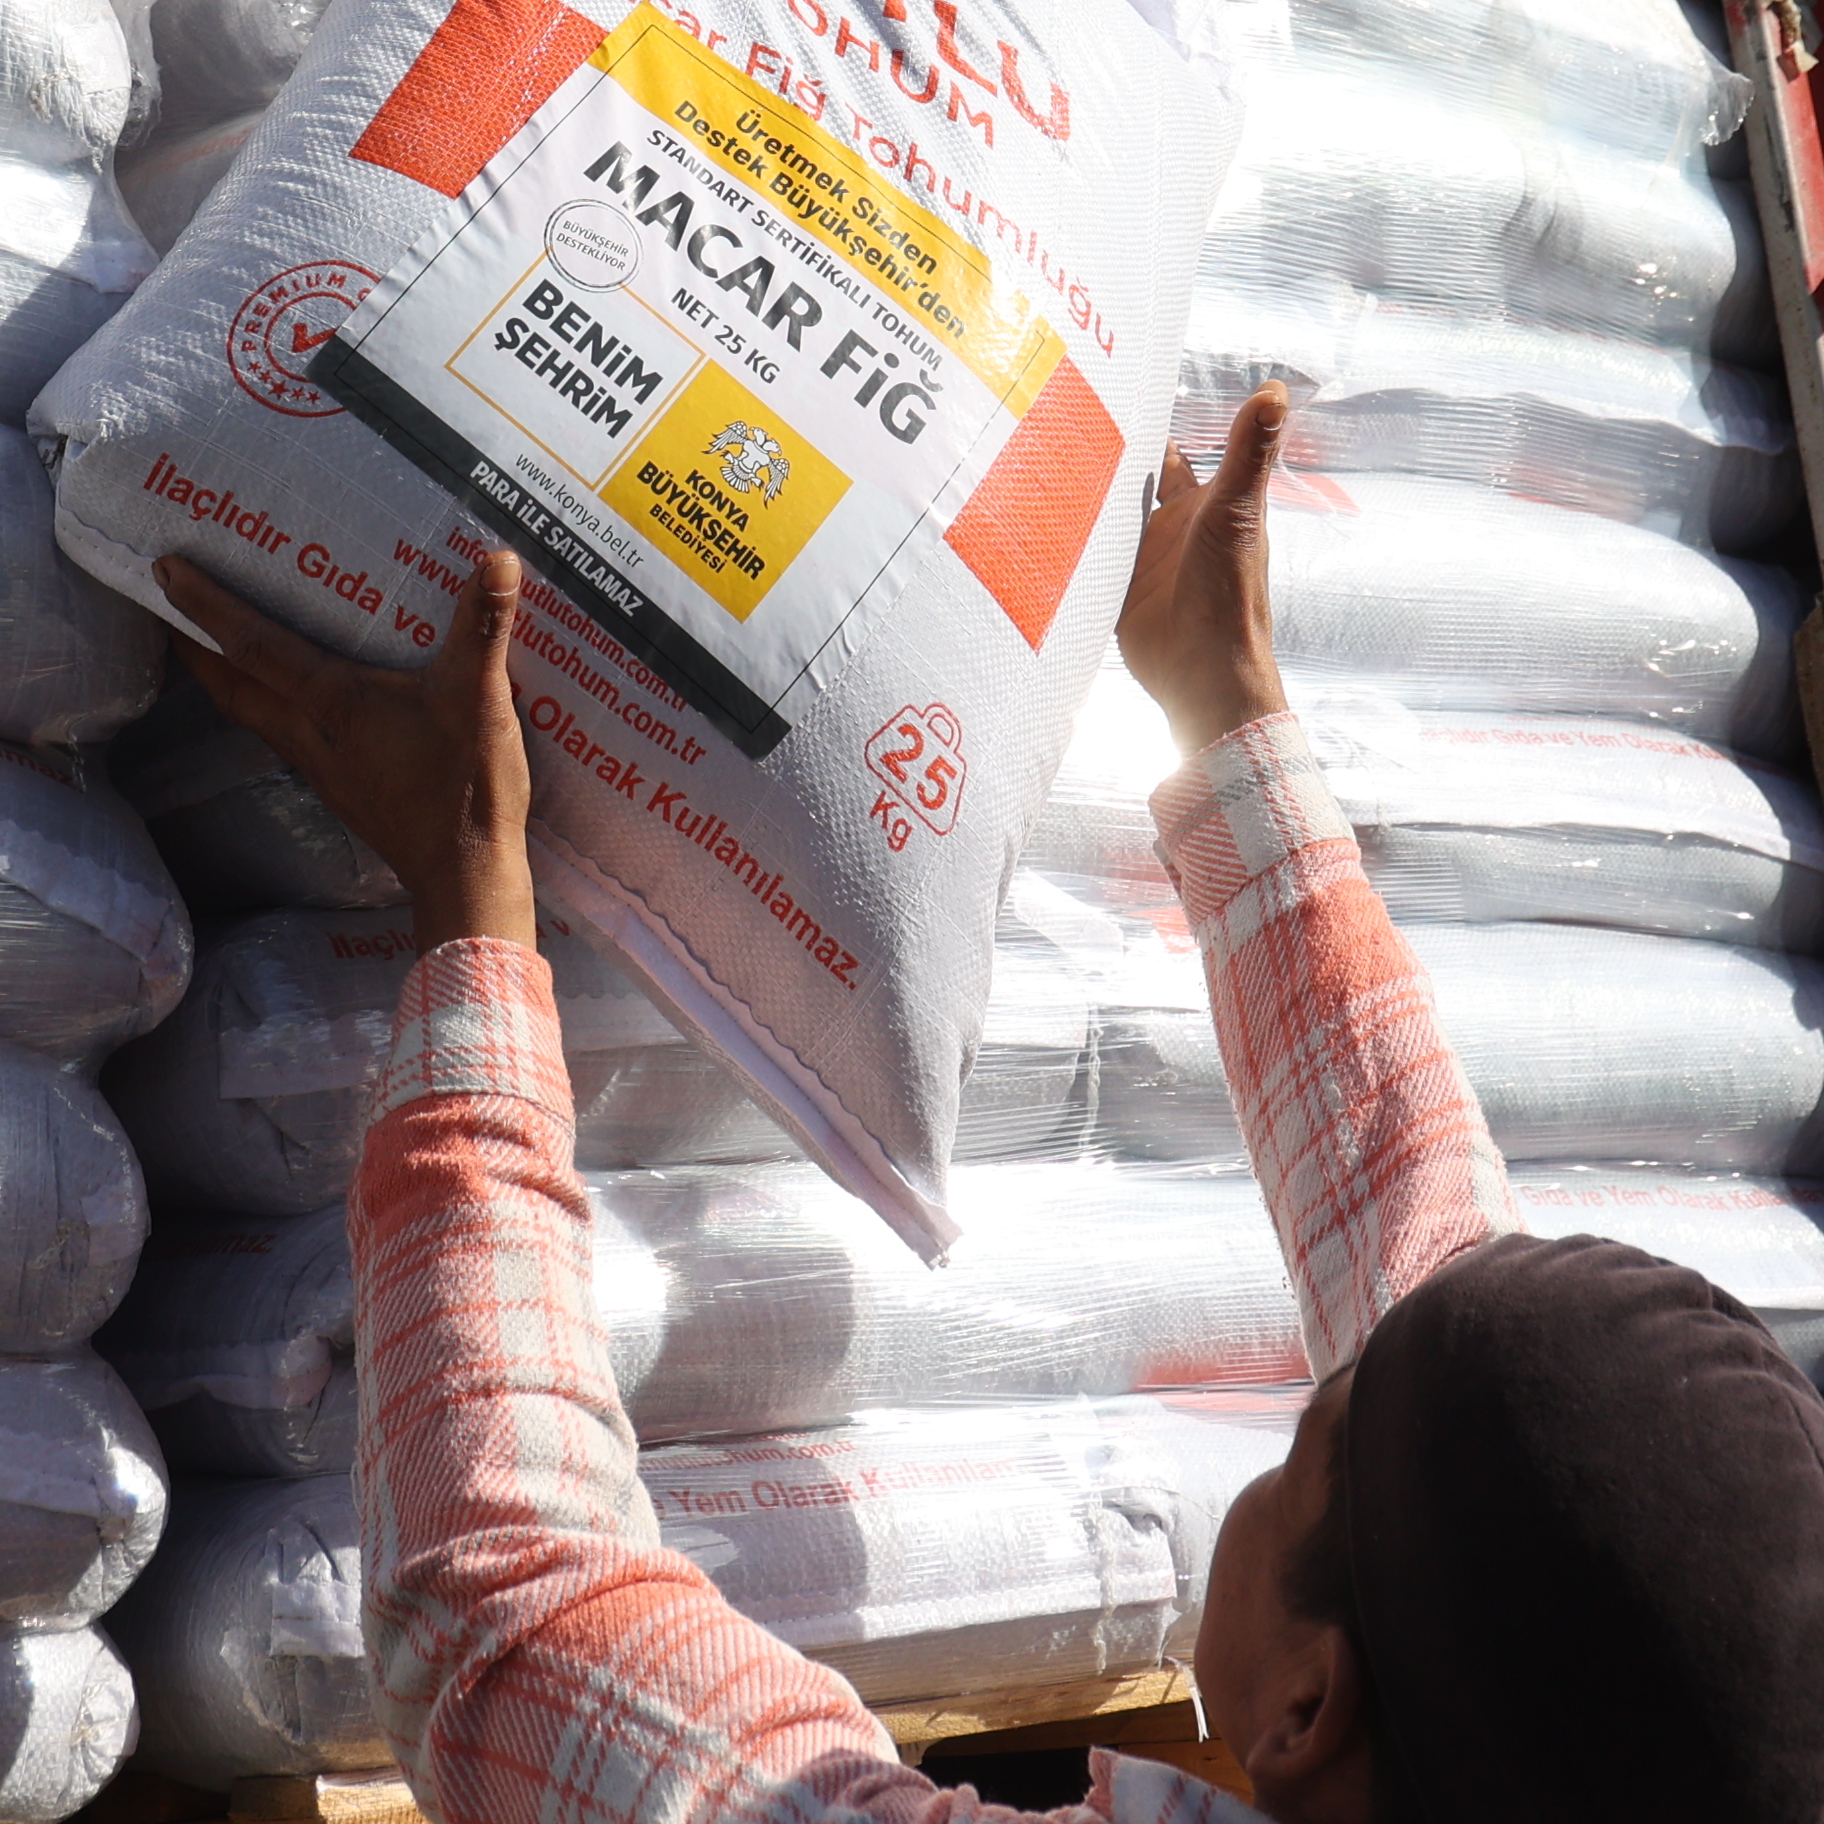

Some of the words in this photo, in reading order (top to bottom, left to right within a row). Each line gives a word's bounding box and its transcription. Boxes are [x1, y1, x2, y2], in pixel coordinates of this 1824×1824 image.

[673, 100, 767, 180] Destek
[562, 219, 630, 258] BÜYÜKŞEHİR
[735, 108, 850, 205] Üretmek
[851, 194, 939, 276] Sizden
[744, 42, 828, 121] Fiğ
[846, 101, 1116, 358] Tohumluğu
[555, 232, 627, 272] DESTEKLİYOR
[583, 140, 824, 354] MACAR
[819, 329, 945, 446] FİĞ
[646, 128, 754, 215] STANDART
[750, 208, 873, 310] SERTİFİKALI
[874, 300, 945, 372] TOHUM
[241, 272, 348, 353] PREMIUM
[522, 278, 665, 406] BENİM
[670, 287, 721, 331] NET
[714, 323, 748, 357] 25
[743, 351, 782, 386] KG
[493, 317, 634, 439] ŞEHRİM
[469, 460, 518, 511] PARA
[543, 525, 646, 618] SATILAMAZ
[515, 453, 645, 569] www.konya.bel.tr
[636, 460, 766, 581] BÜYÜKŞEHİR
[648, 504, 728, 575] BELEDİYESİ
[684, 468, 750, 533] KONYA
[295, 542, 385, 616] Gıda
[393, 604, 437, 649] ve
[879, 723, 959, 811] 25
[528, 695, 646, 801] Olarak
[646, 782, 863, 991] Kullanılamaz.
[869, 790, 915, 853] Kg
[1574, 1189, 1601, 1208] ve
[1600, 1185, 1659, 1208] Yem
[667, 1487, 748, 1518] Yem
[751, 1479, 861, 1511] Olarak
